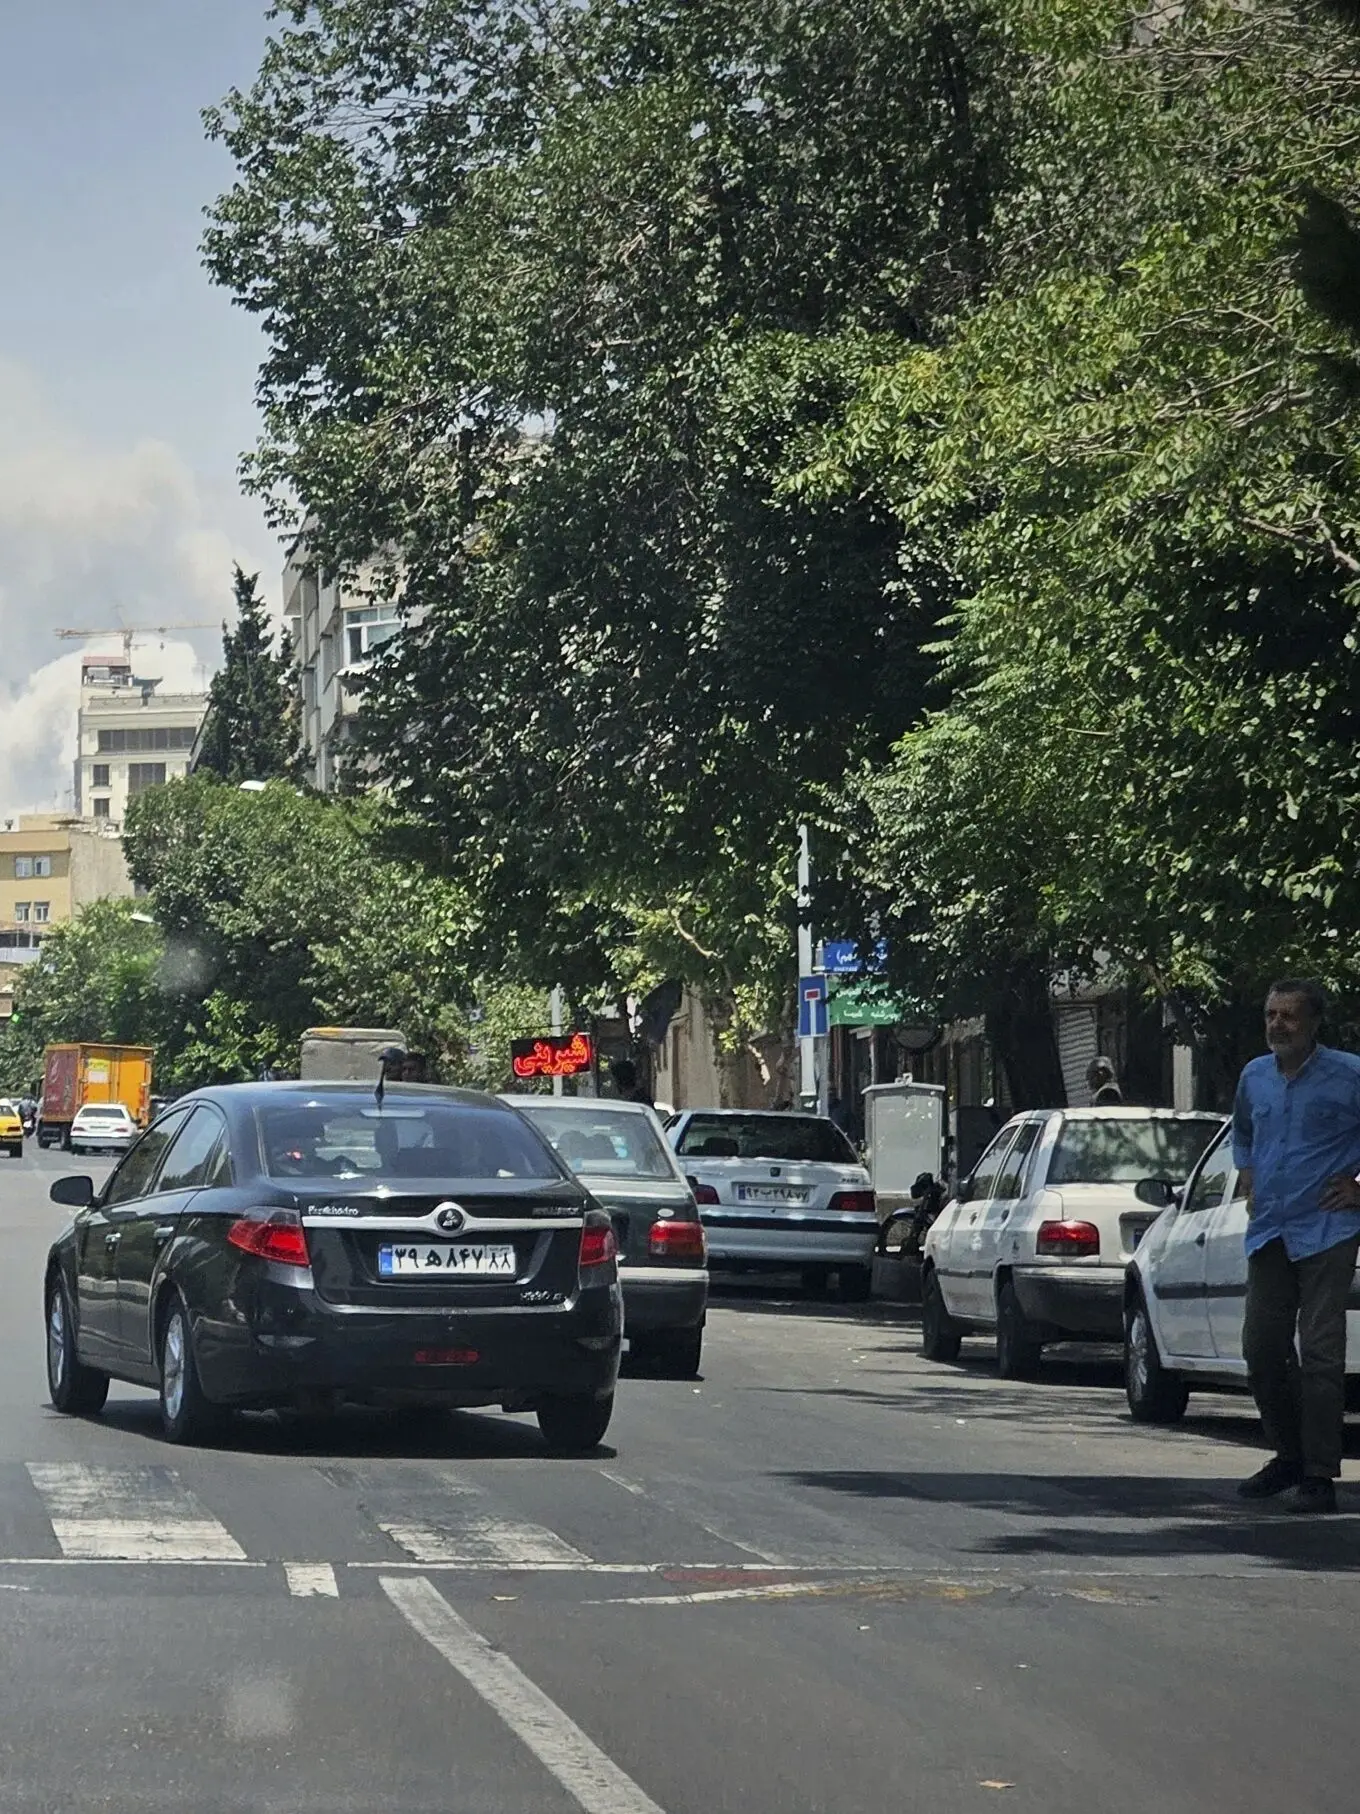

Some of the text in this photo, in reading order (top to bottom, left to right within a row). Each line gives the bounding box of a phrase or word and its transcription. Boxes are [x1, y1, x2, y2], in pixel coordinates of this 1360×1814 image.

[513, 1034, 588, 1077] شیرینی
[394, 1247, 419, 1269] ۳۹
[446, 1247, 483, 1270] ۸۴۷
[489, 1252, 511, 1270] ۸۸
